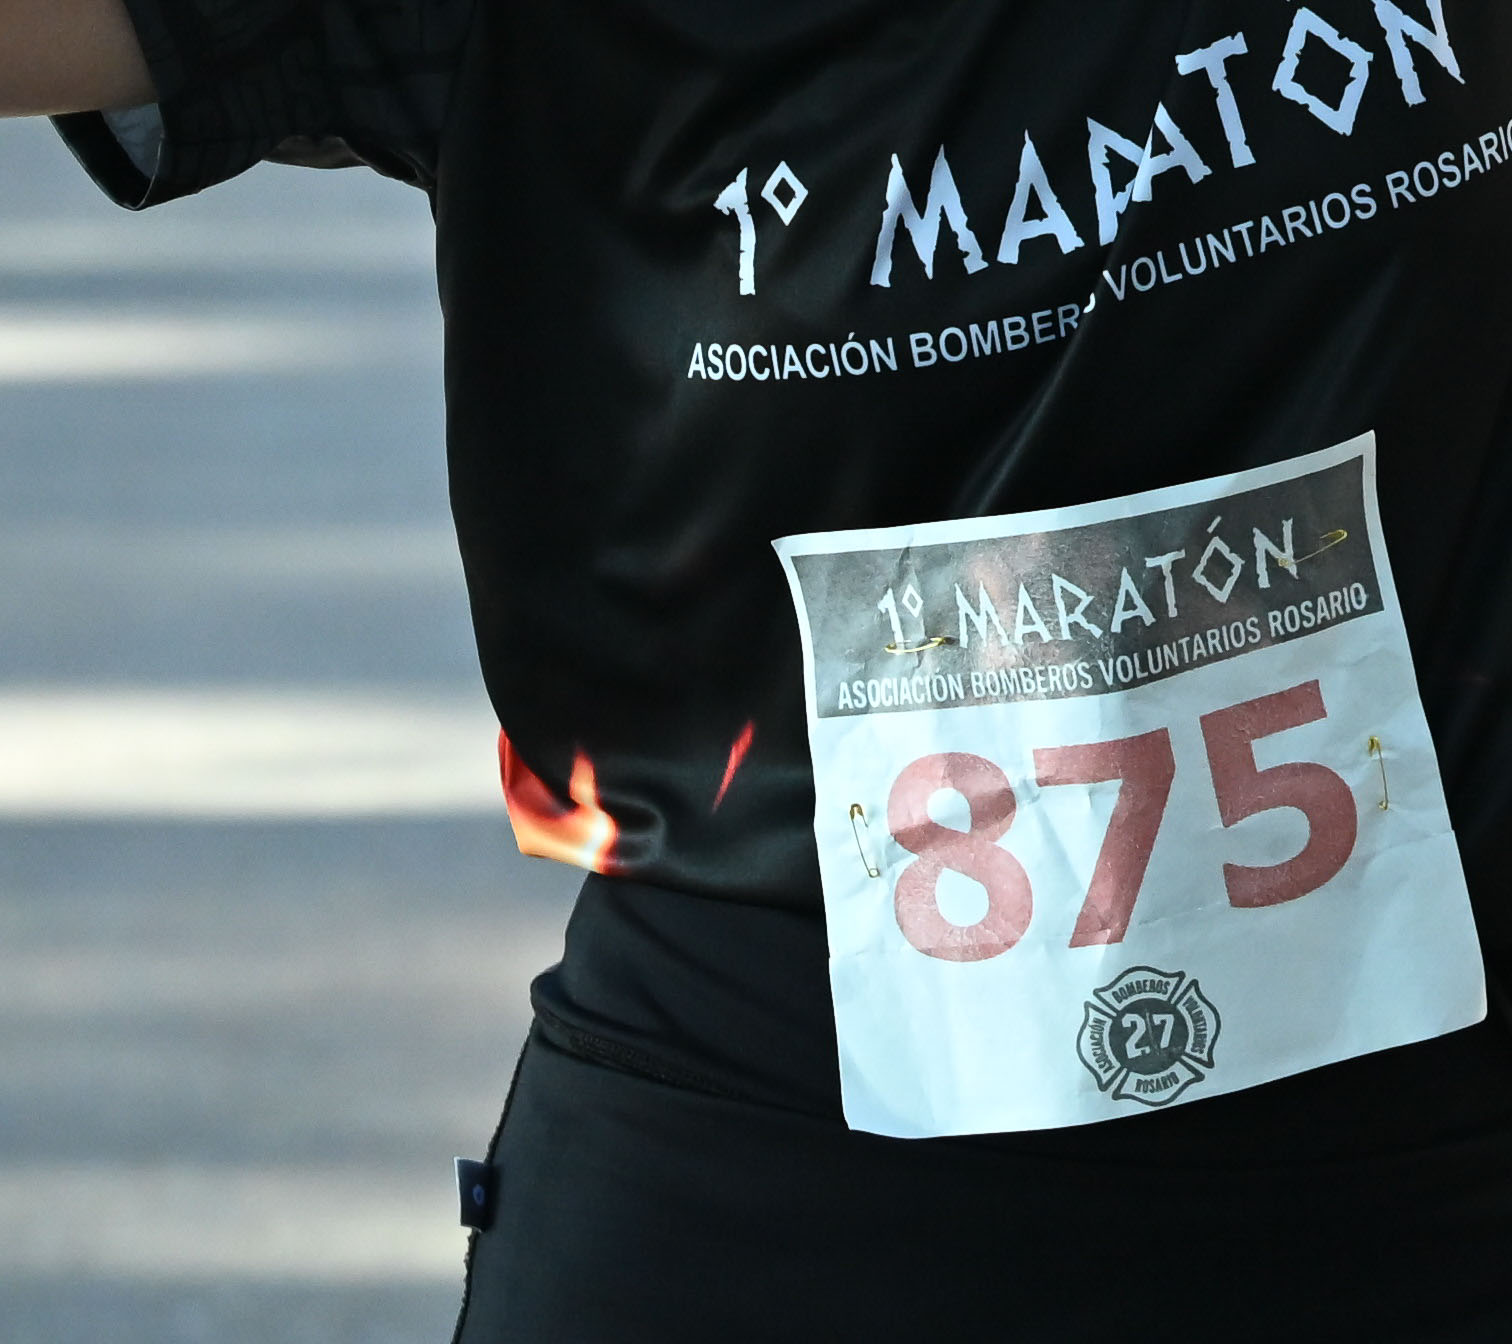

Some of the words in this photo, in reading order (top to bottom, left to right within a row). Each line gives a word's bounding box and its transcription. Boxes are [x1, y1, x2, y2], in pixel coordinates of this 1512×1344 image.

[687, 331, 898, 381] ASOCIACIÓN
[908, 292, 1096, 369] BOMBER
[1102, 183, 1378, 302] VOLUNTARIOS
[838, 668, 965, 710] ASOCIACIÓN
[970, 660, 1094, 700] BOMBEROS
[1099, 616, 1262, 687] VOLUNTARIOS
[1267, 582, 1367, 639] ROSARIO
[954, 515, 1300, 649] MARATÓN
[886, 678, 1359, 963] 875
[1111, 978, 1171, 1004] BOMBEROS
[1121, 1013, 1175, 1059] 27
[1134, 1071, 1180, 1094] ROSARIO
